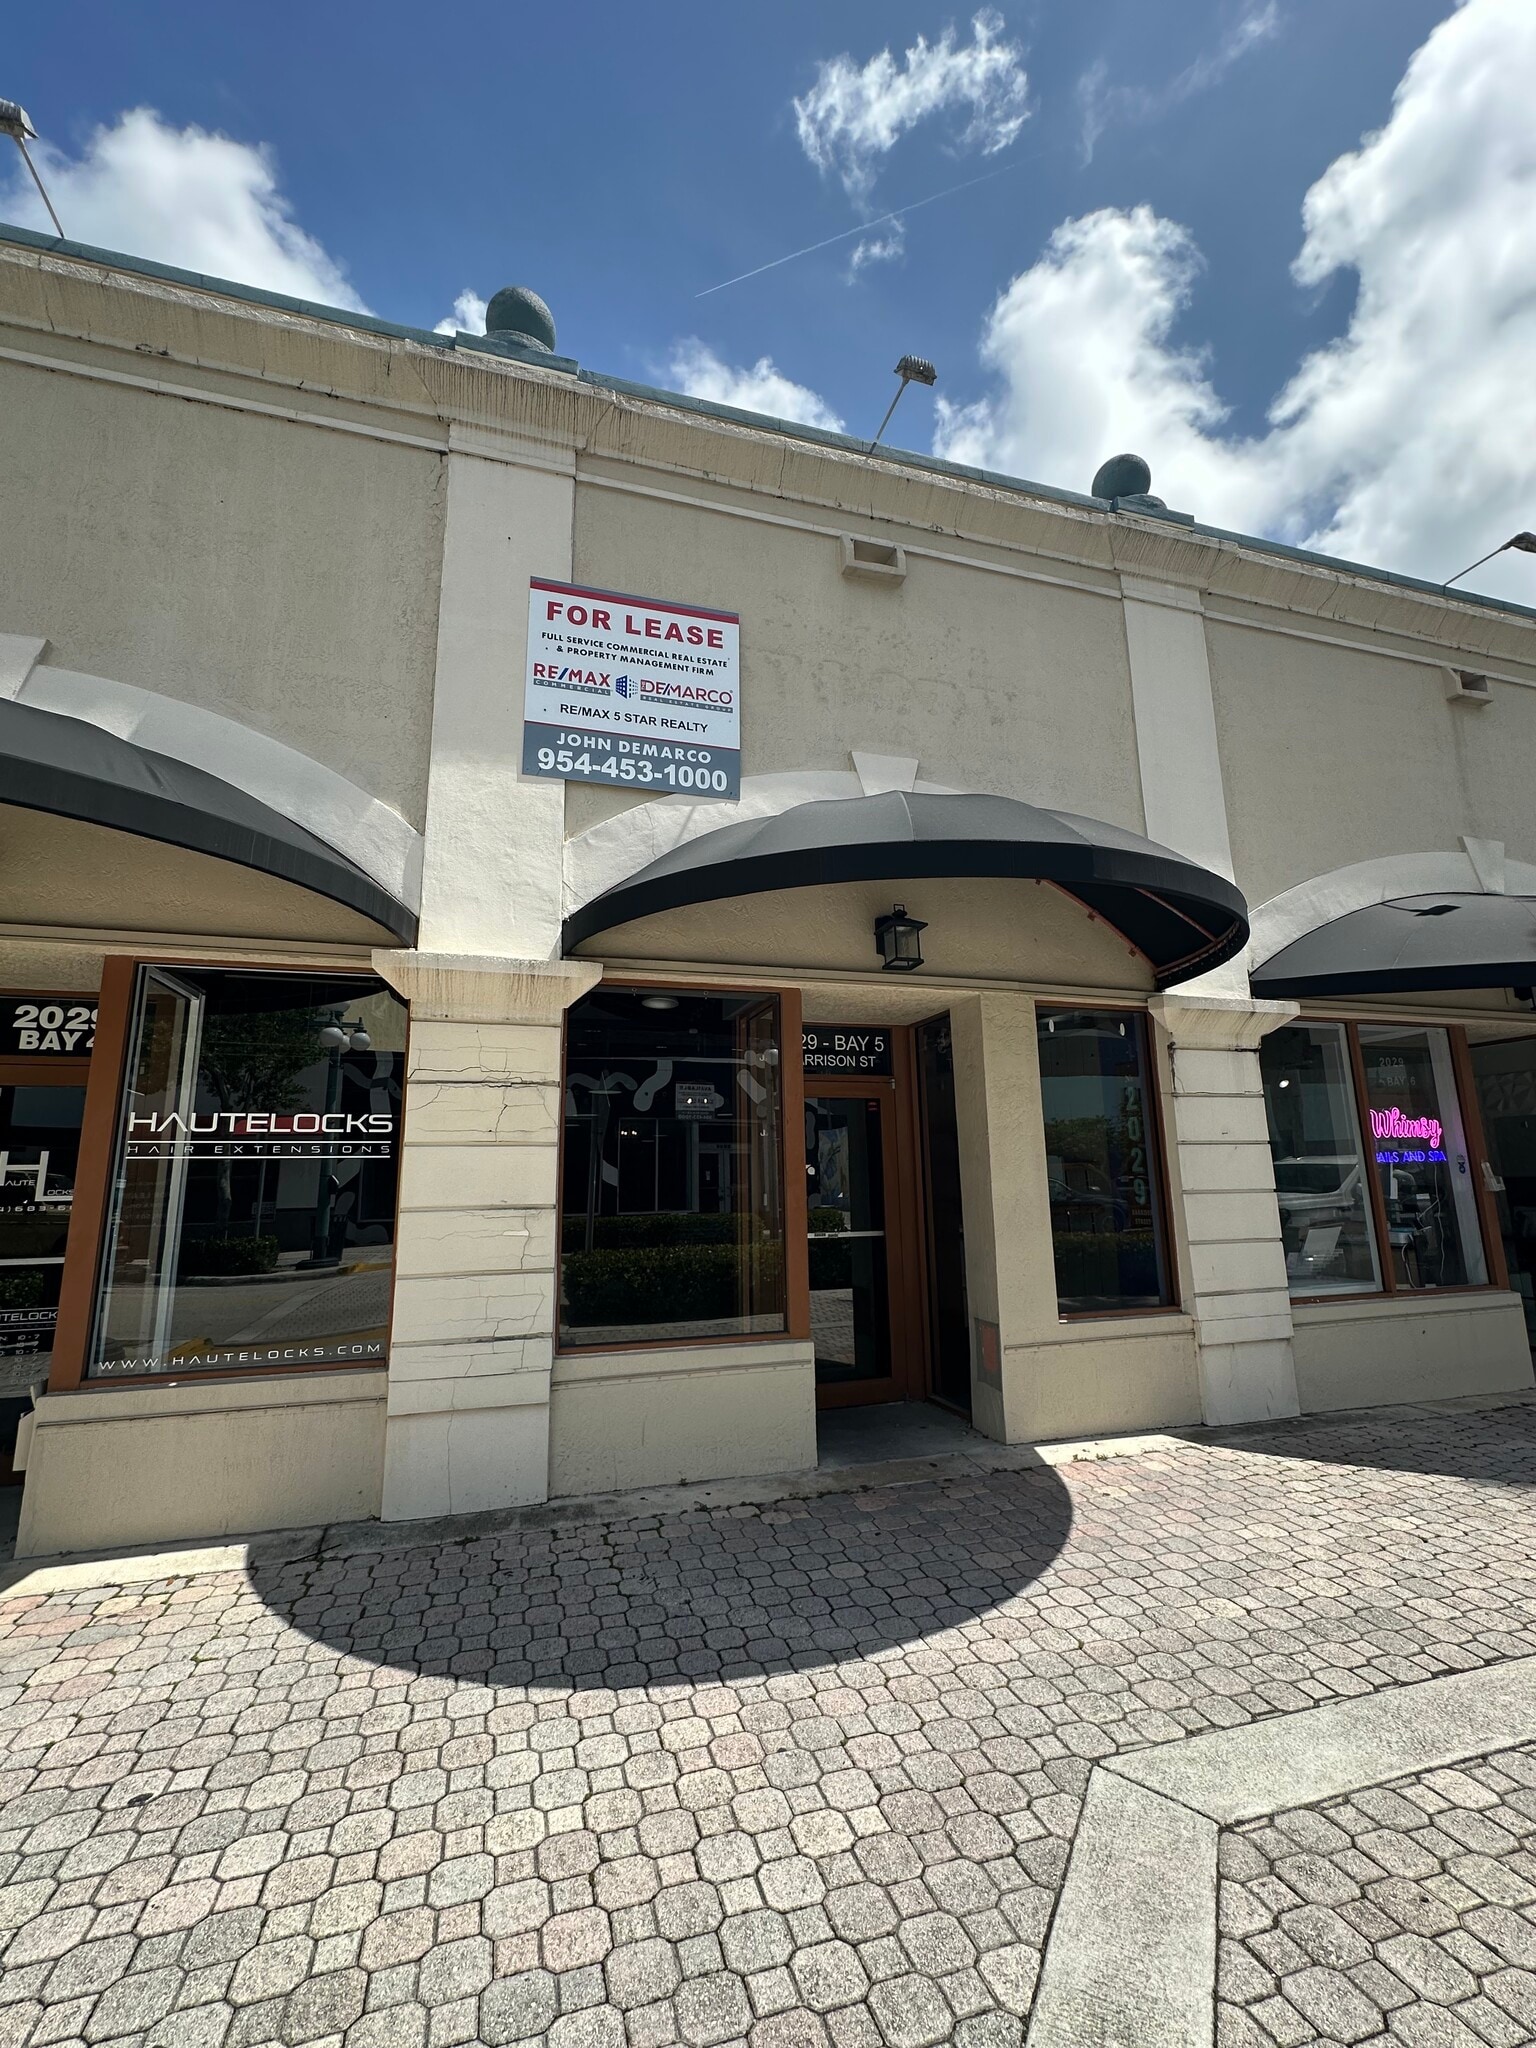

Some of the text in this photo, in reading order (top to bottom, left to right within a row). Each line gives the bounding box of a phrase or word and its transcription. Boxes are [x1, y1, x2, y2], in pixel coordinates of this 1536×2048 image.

[547, 600, 724, 649] FOR LEASE
[541, 631, 728, 668] FULL SERVICE COMMERCIAL REAL ESTATE
[556, 645, 714, 677] & PROPERTY MANAGEMENT FIRM
[533, 662, 611, 688] RE/MAX
[534, 679, 610, 696] COMMERCIAL
[640, 679, 733, 705] DE/MARCO
[642, 695, 664, 703] REAL
[668, 699, 700, 708] ESTATE
[560, 703, 708, 733] RE/MAX 5 STAR REALTY
[557, 732, 712, 764] JOHN DEMARCO
[537, 747, 728, 792] 954-453-1000
[19, 1029, 83, 1051] BAY
[834, 1035, 869, 1051] BAY
[874, 1036, 884, 1052] 5
[803, 1054, 876, 1067] RRISON ST
[128, 1111, 393, 1133] HAUTELOCKS
[1369, 1106, 1443, 1149] Whimsy
[127, 1144, 390, 1154] HAIR EXTENSIONS
[1402, 1151, 1426, 1163] AND
[1428, 1150, 1447, 1162] SPA
[99, 1343, 381, 1370] WWW.HAUTELOCKS.COM
